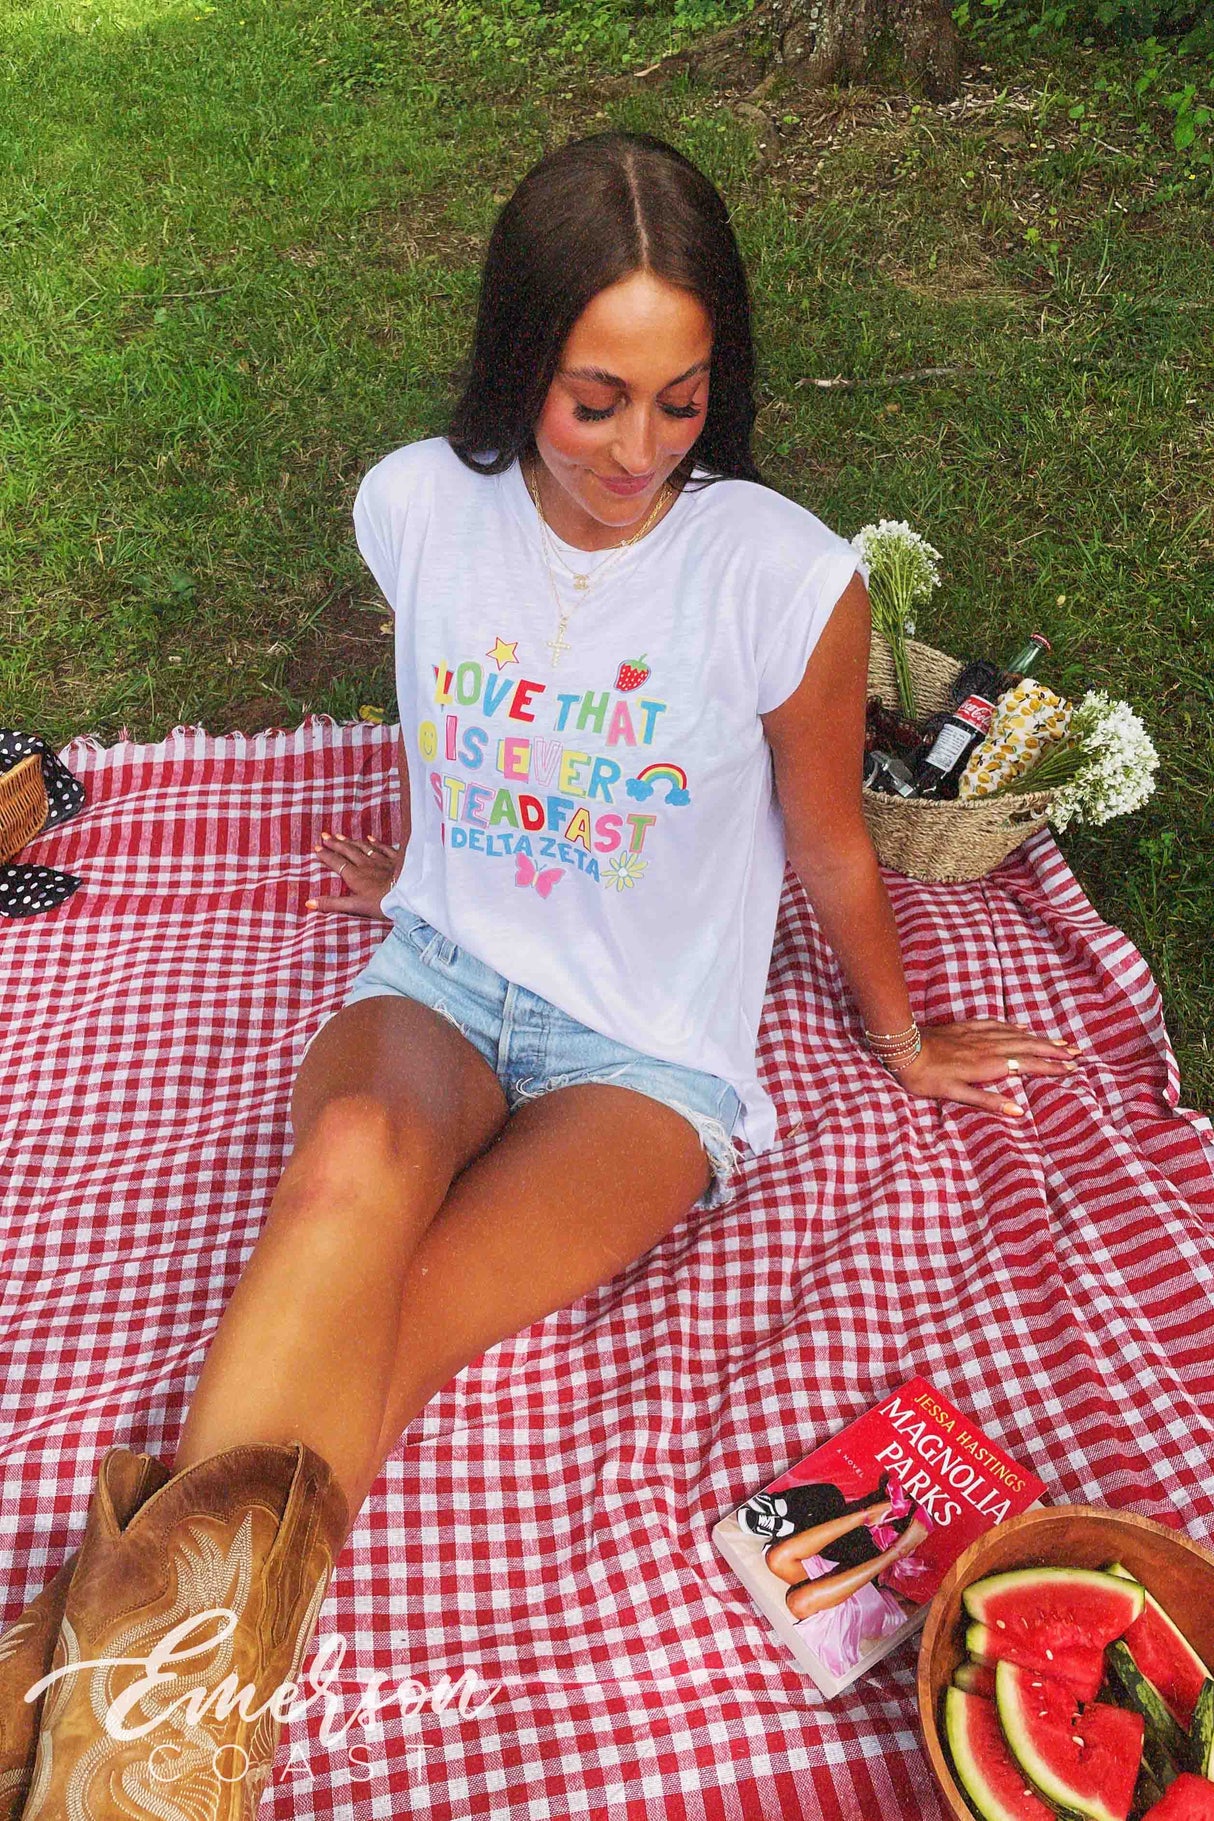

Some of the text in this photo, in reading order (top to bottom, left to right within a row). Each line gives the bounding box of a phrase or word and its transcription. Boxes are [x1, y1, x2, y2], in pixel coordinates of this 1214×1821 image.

[432, 660, 667, 746] LOVE THAT
[445, 715, 621, 804] IS EVER
[430, 772, 657, 854] STEADFAST
[451, 827, 601, 883] DELTA ZETA
[842, 1454, 866, 1480] NOVEL
[874, 1441, 962, 1527] PARKS
[879, 1397, 1012, 1526] MAGNOLIA
[914, 1394, 1026, 1493] JESSA HASTINGS
